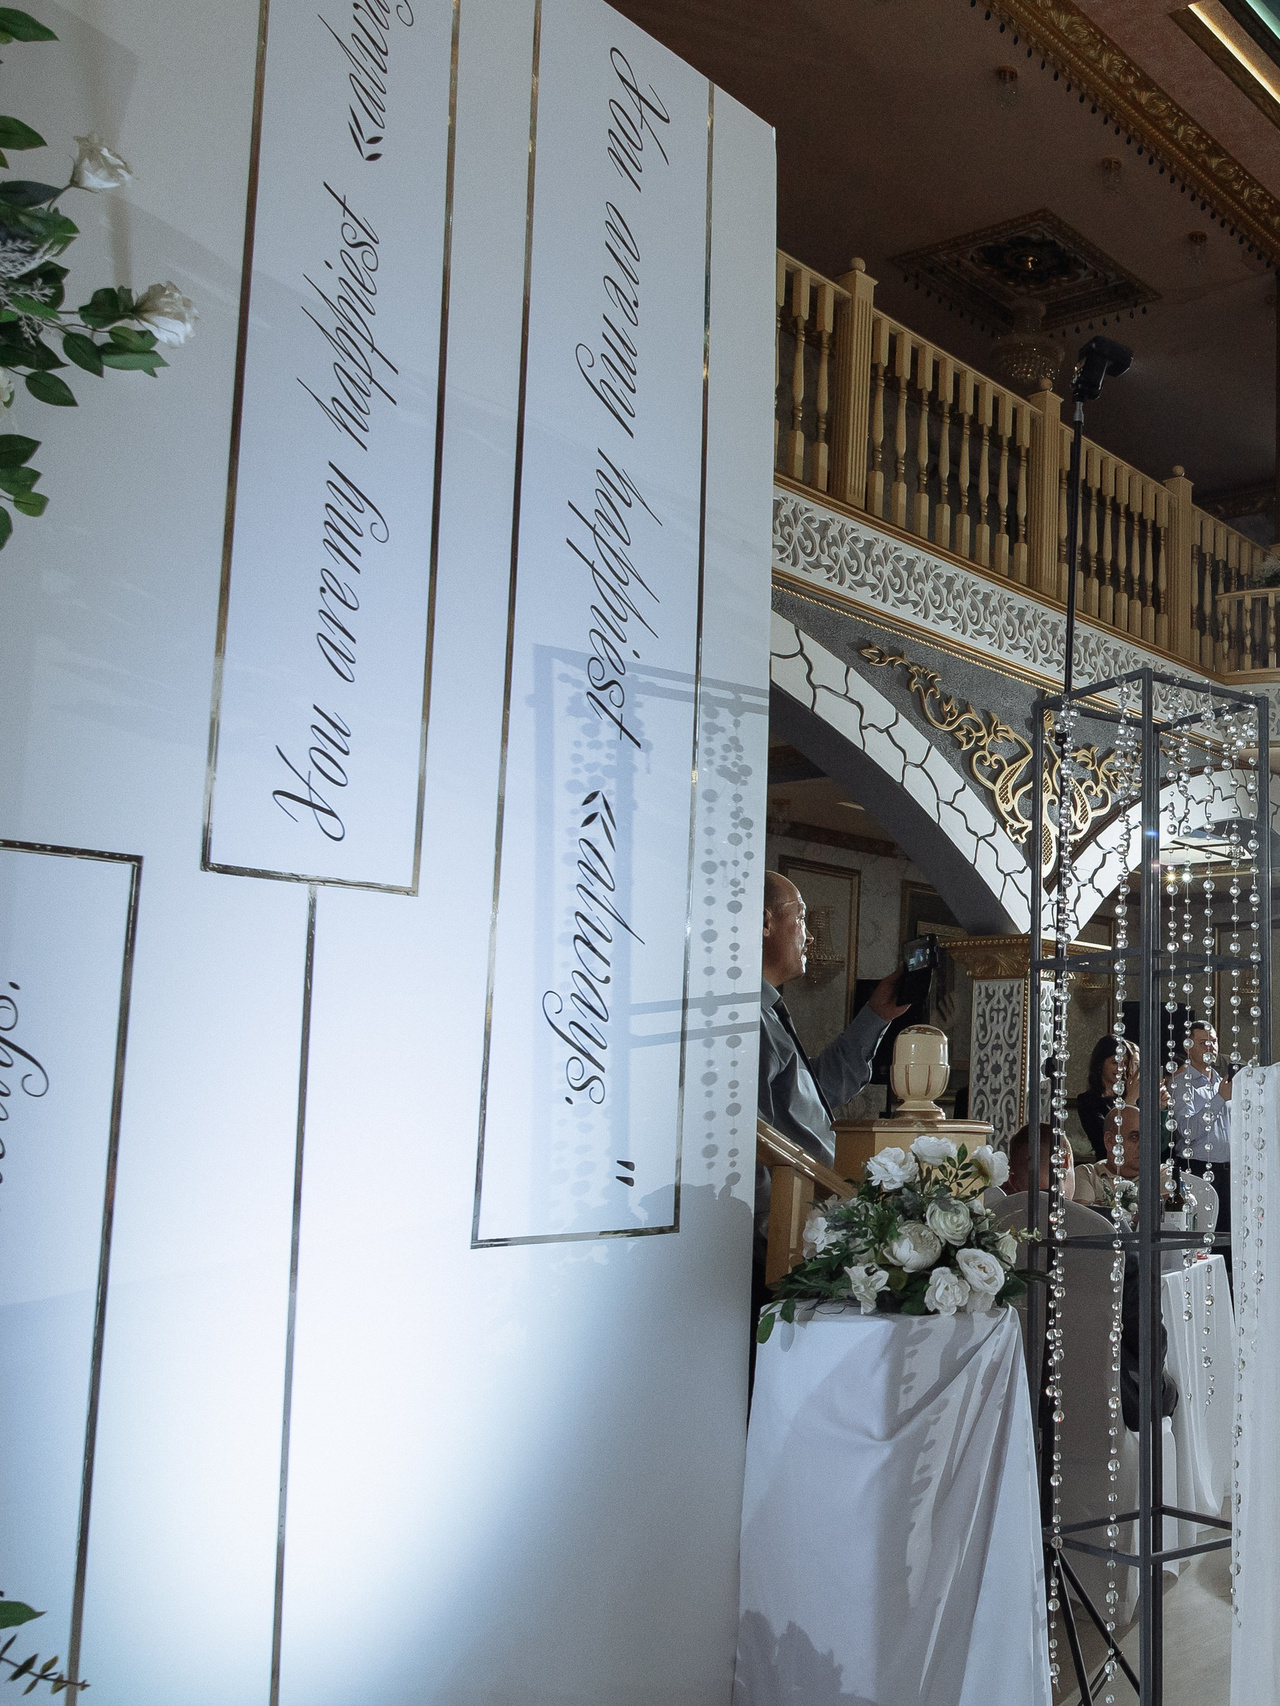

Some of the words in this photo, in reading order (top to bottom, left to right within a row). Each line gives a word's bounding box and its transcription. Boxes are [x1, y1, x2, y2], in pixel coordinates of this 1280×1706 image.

[608, 47, 670, 193] You
[297, 181, 398, 451] happiest
[566, 448, 663, 749] happiest
[272, 704, 351, 842] You
